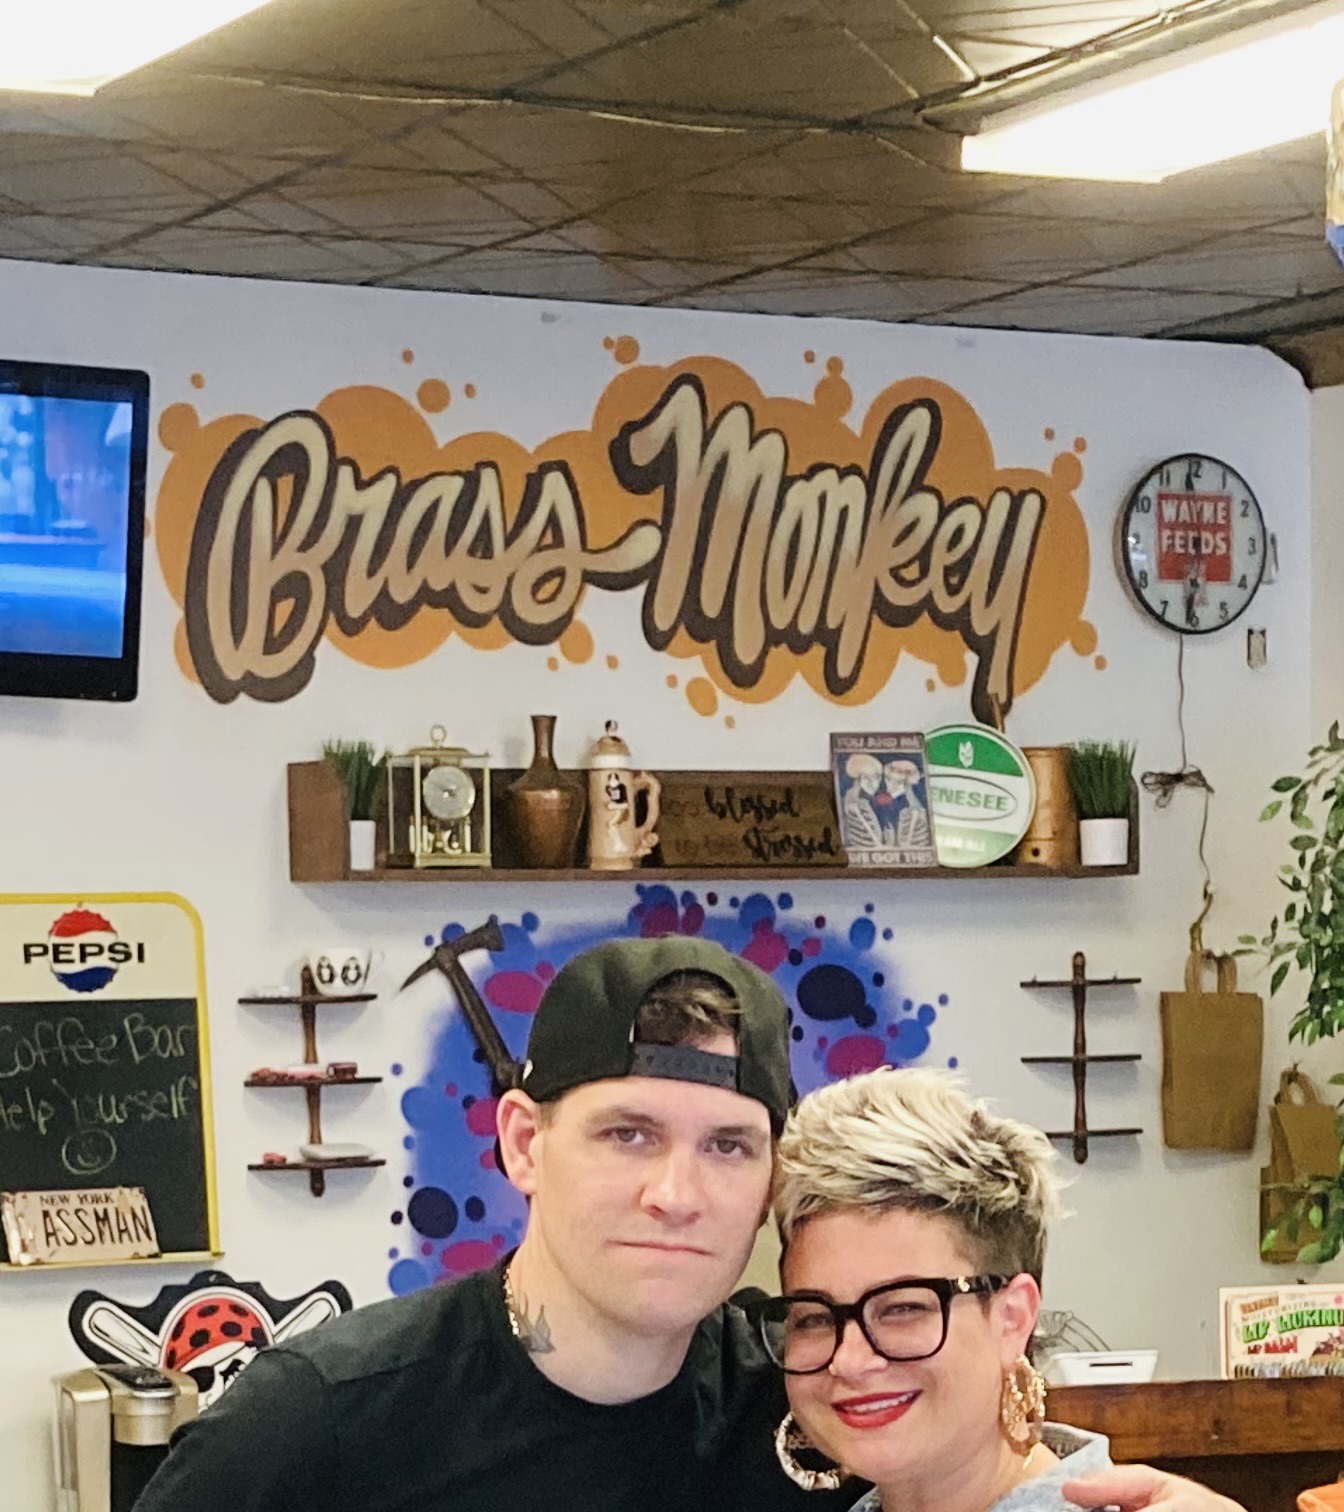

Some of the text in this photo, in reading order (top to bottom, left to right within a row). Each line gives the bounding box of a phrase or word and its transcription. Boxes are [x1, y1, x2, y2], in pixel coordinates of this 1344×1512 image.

[1161, 499, 1227, 524] WAYNE
[186, 373, 1046, 720] Brass Monkey
[1161, 529, 1228, 555] FEEDS
[930, 786, 1009, 811] ENESEE
[23, 942, 145, 964] PEPSI
[123, 1012, 197, 1065] Bar
[40, 1192, 115, 1206] NEW YORK
[41, 1205, 153, 1248] ASSMAN
